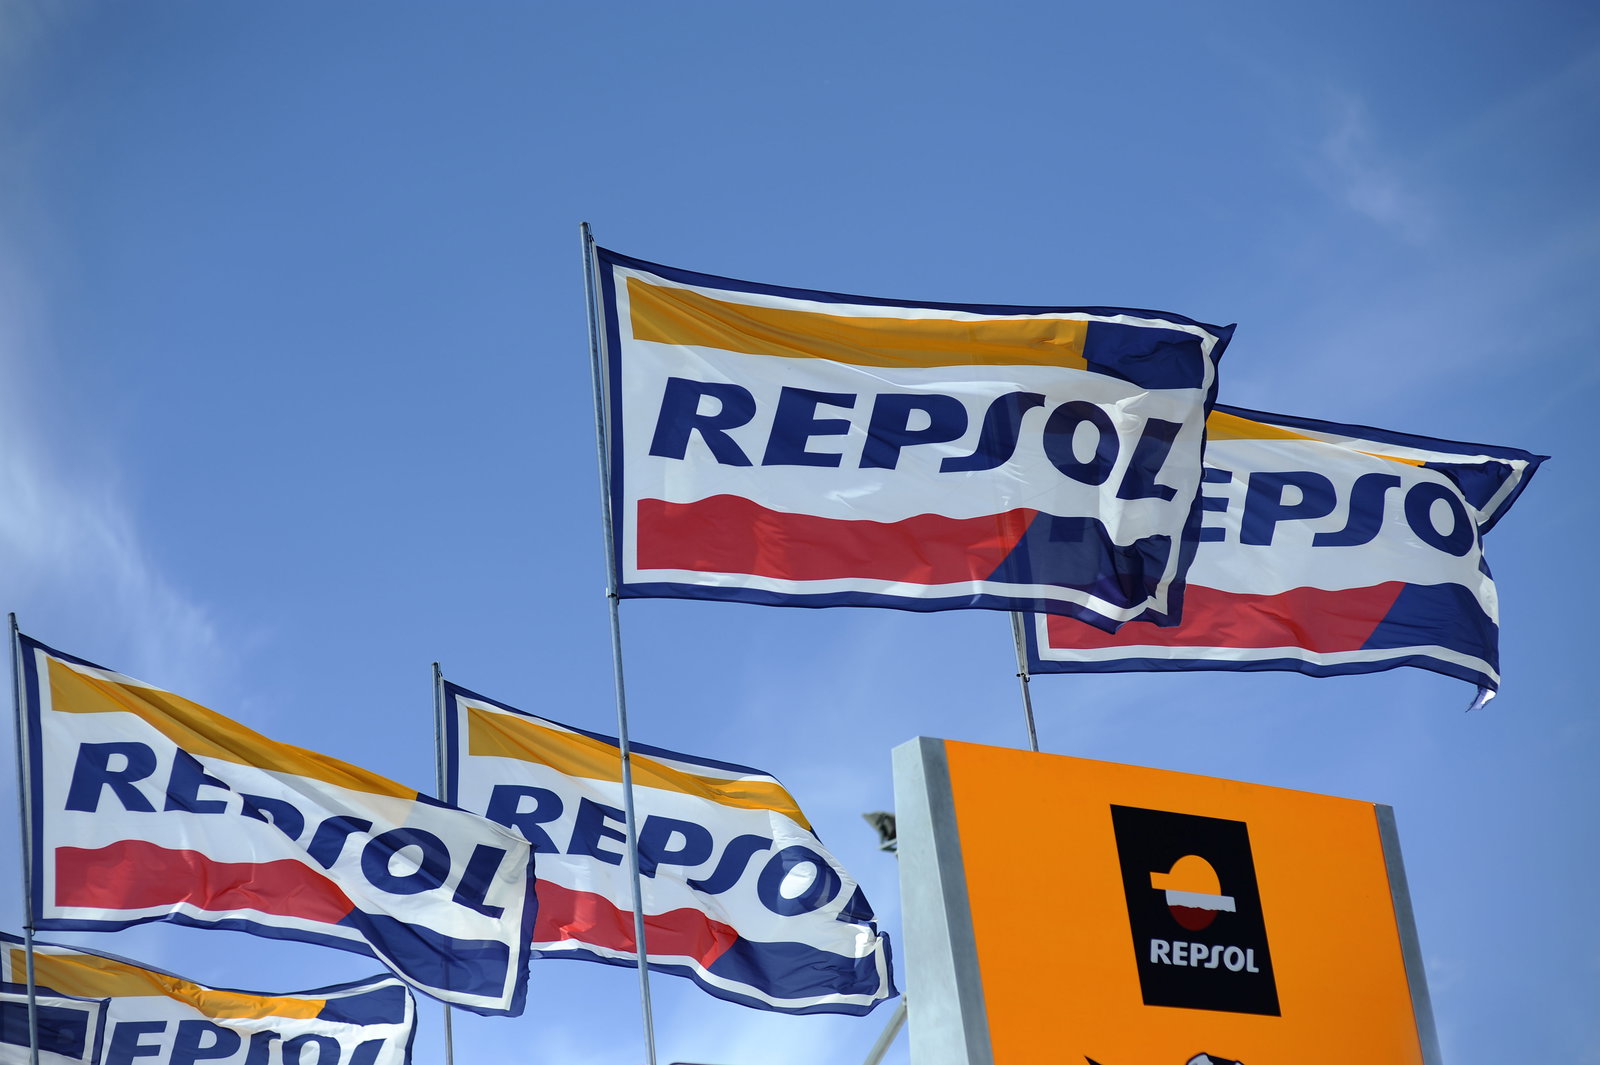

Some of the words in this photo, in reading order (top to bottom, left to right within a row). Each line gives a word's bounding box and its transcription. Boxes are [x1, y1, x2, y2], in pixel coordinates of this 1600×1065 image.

[649, 377, 1183, 502] REPSOL
[1201, 467, 1475, 557] EPSO
[1150, 939, 1259, 973] REPSOL
